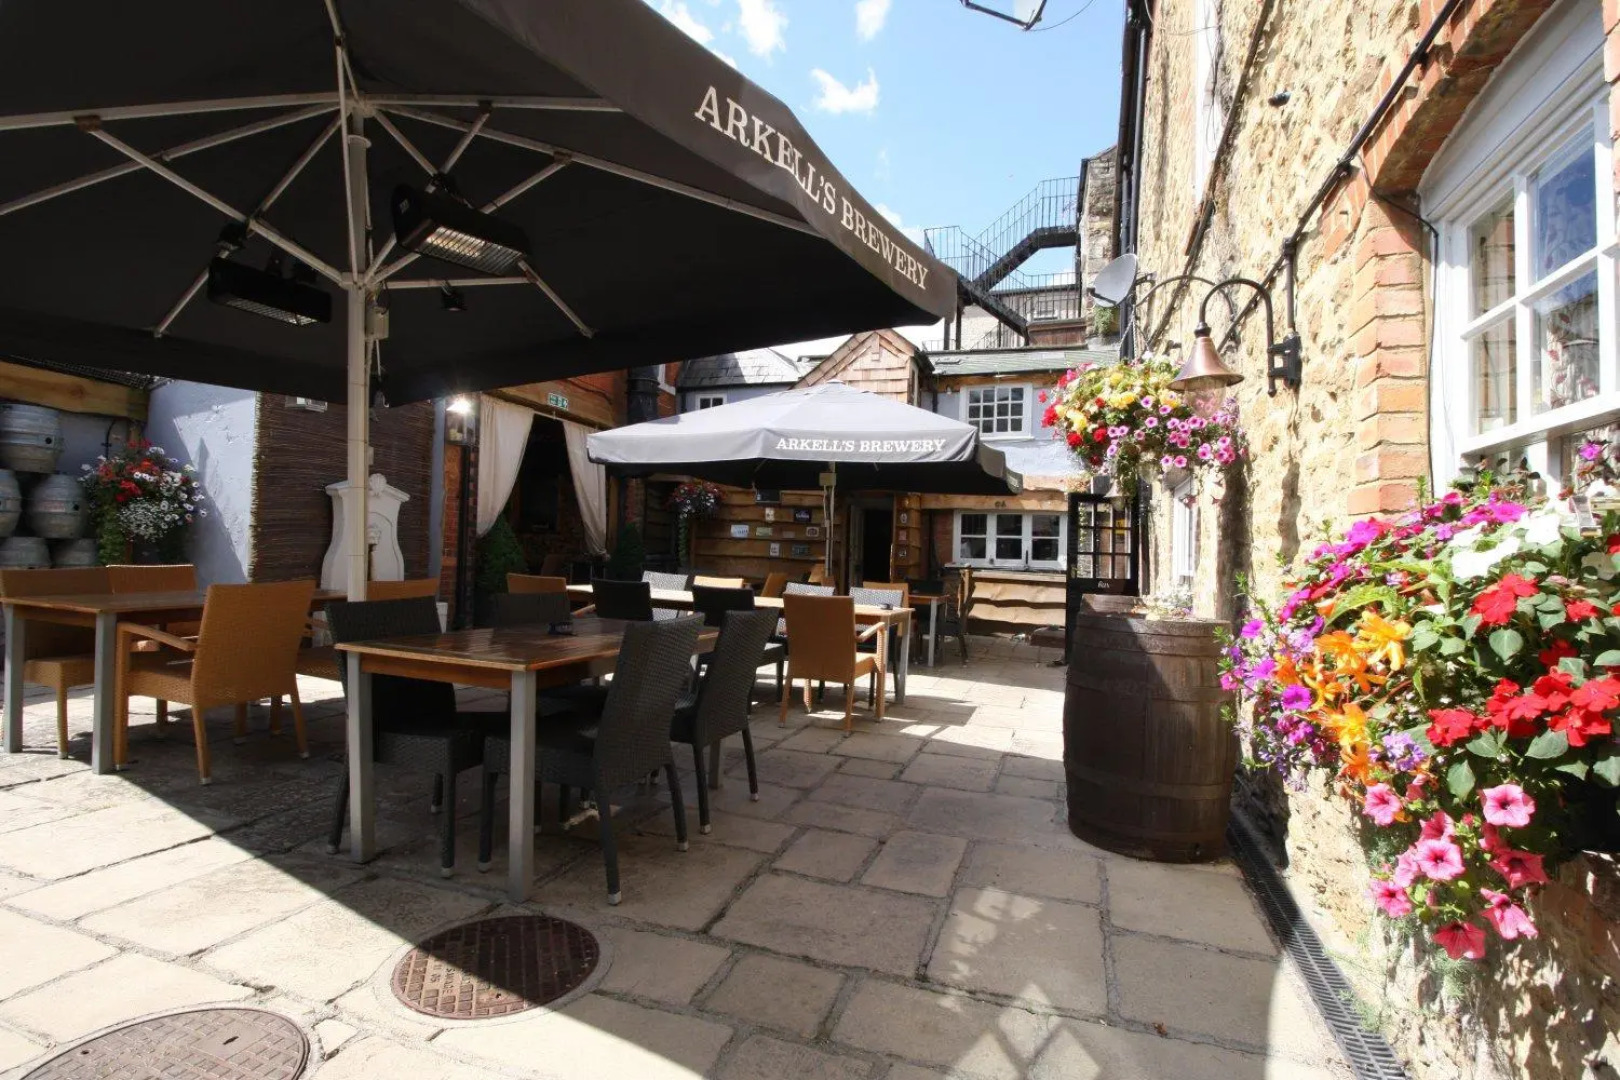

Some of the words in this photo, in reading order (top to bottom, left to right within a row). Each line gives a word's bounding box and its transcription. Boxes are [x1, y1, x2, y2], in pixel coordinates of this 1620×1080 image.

[694, 85, 836, 215] ARKELL'S
[841, 197, 929, 290] BREWERY
[776, 437, 855, 452] ARKELL'S
[859, 438, 946, 453] BREWERY
